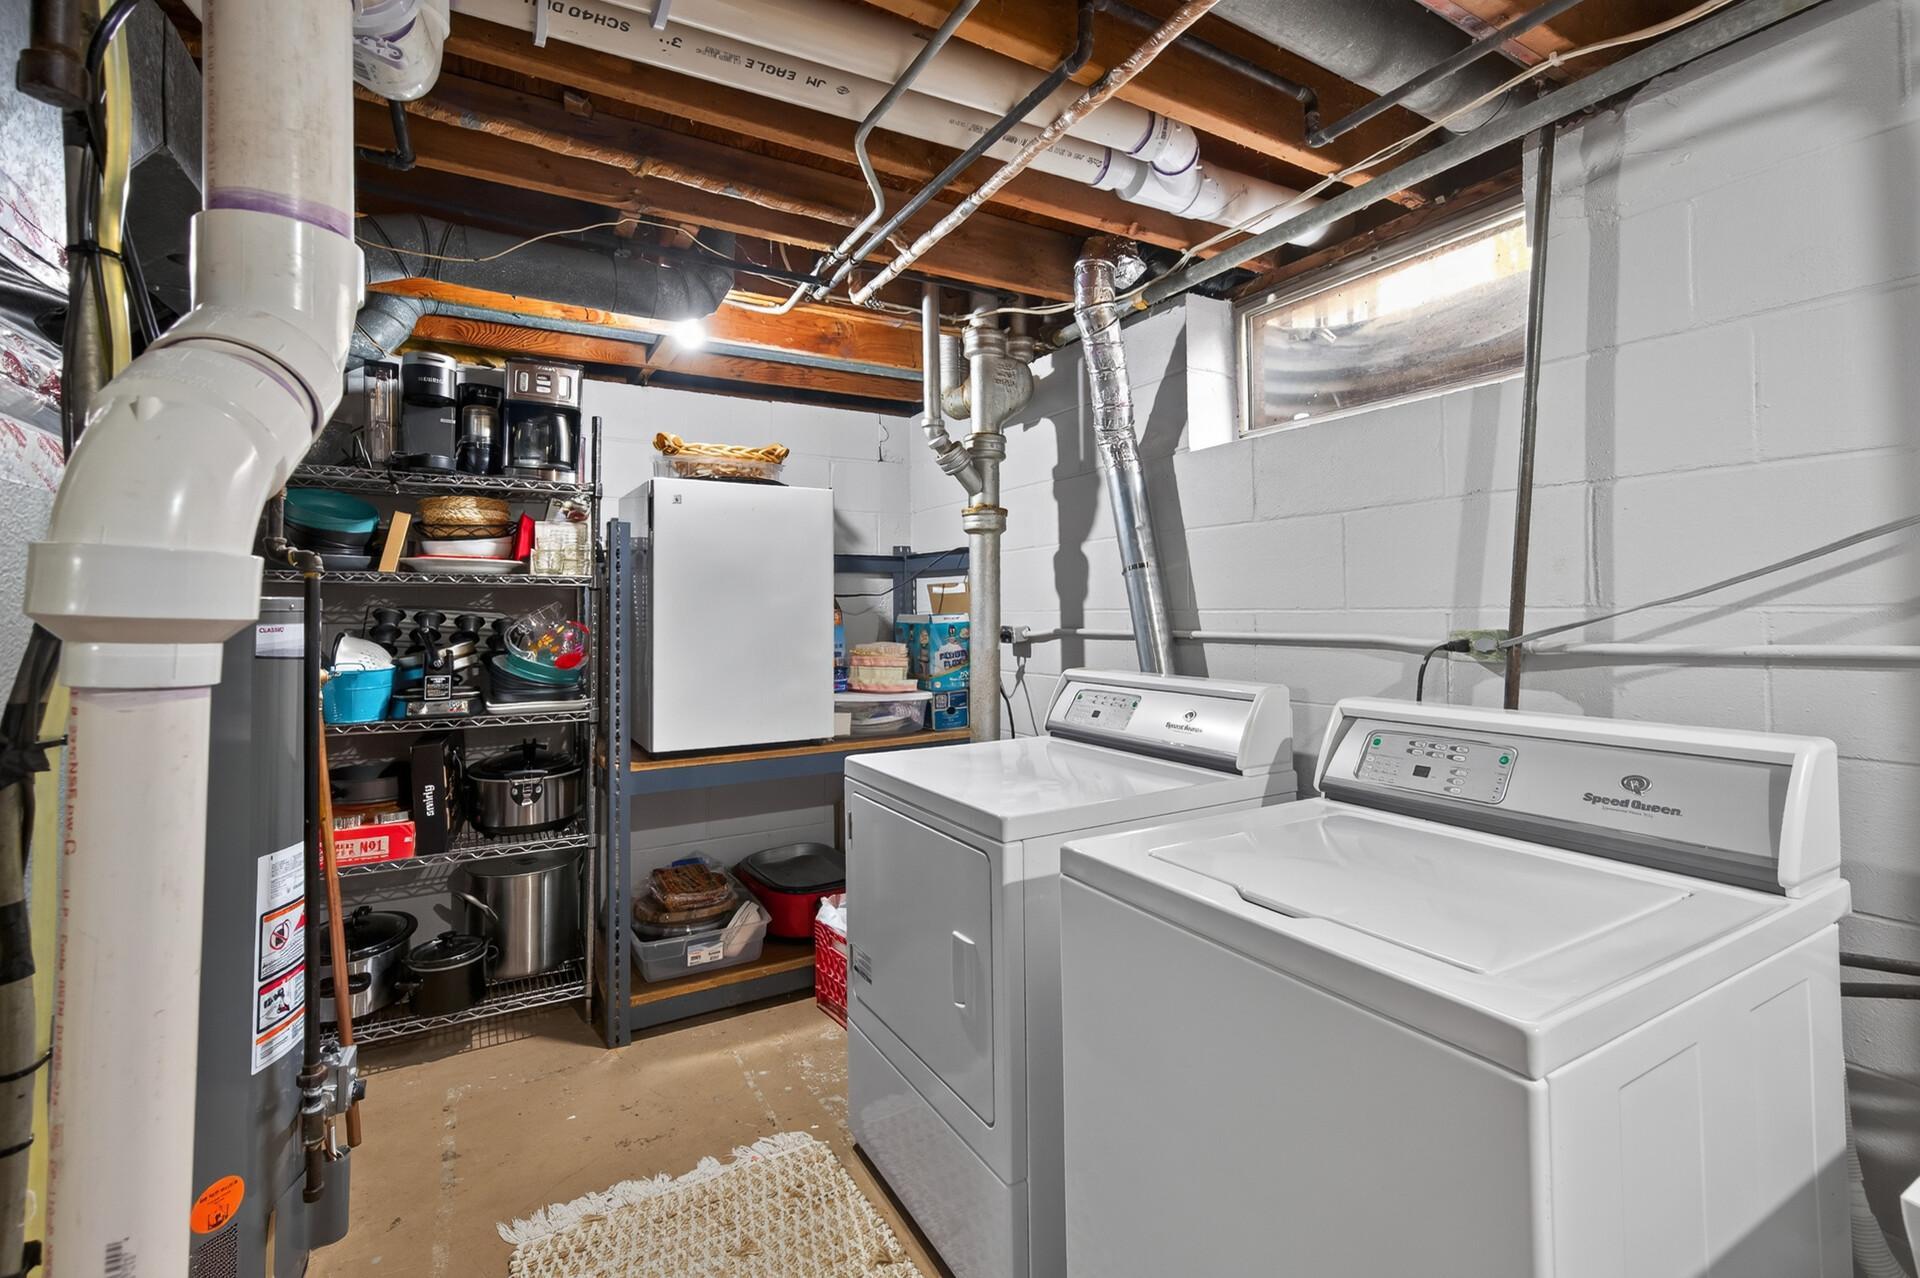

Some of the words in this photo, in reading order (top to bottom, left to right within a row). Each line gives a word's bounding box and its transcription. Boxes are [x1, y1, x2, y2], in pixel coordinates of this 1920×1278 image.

[568, 6, 632, 33] SCH40
[745, 58, 797, 81] EAGLE
[806, 75, 827, 88] JM
[259, 626, 285, 634] CLASSIC
[1582, 792, 1630, 808] Speed
[1631, 799, 1682, 817] Queen
